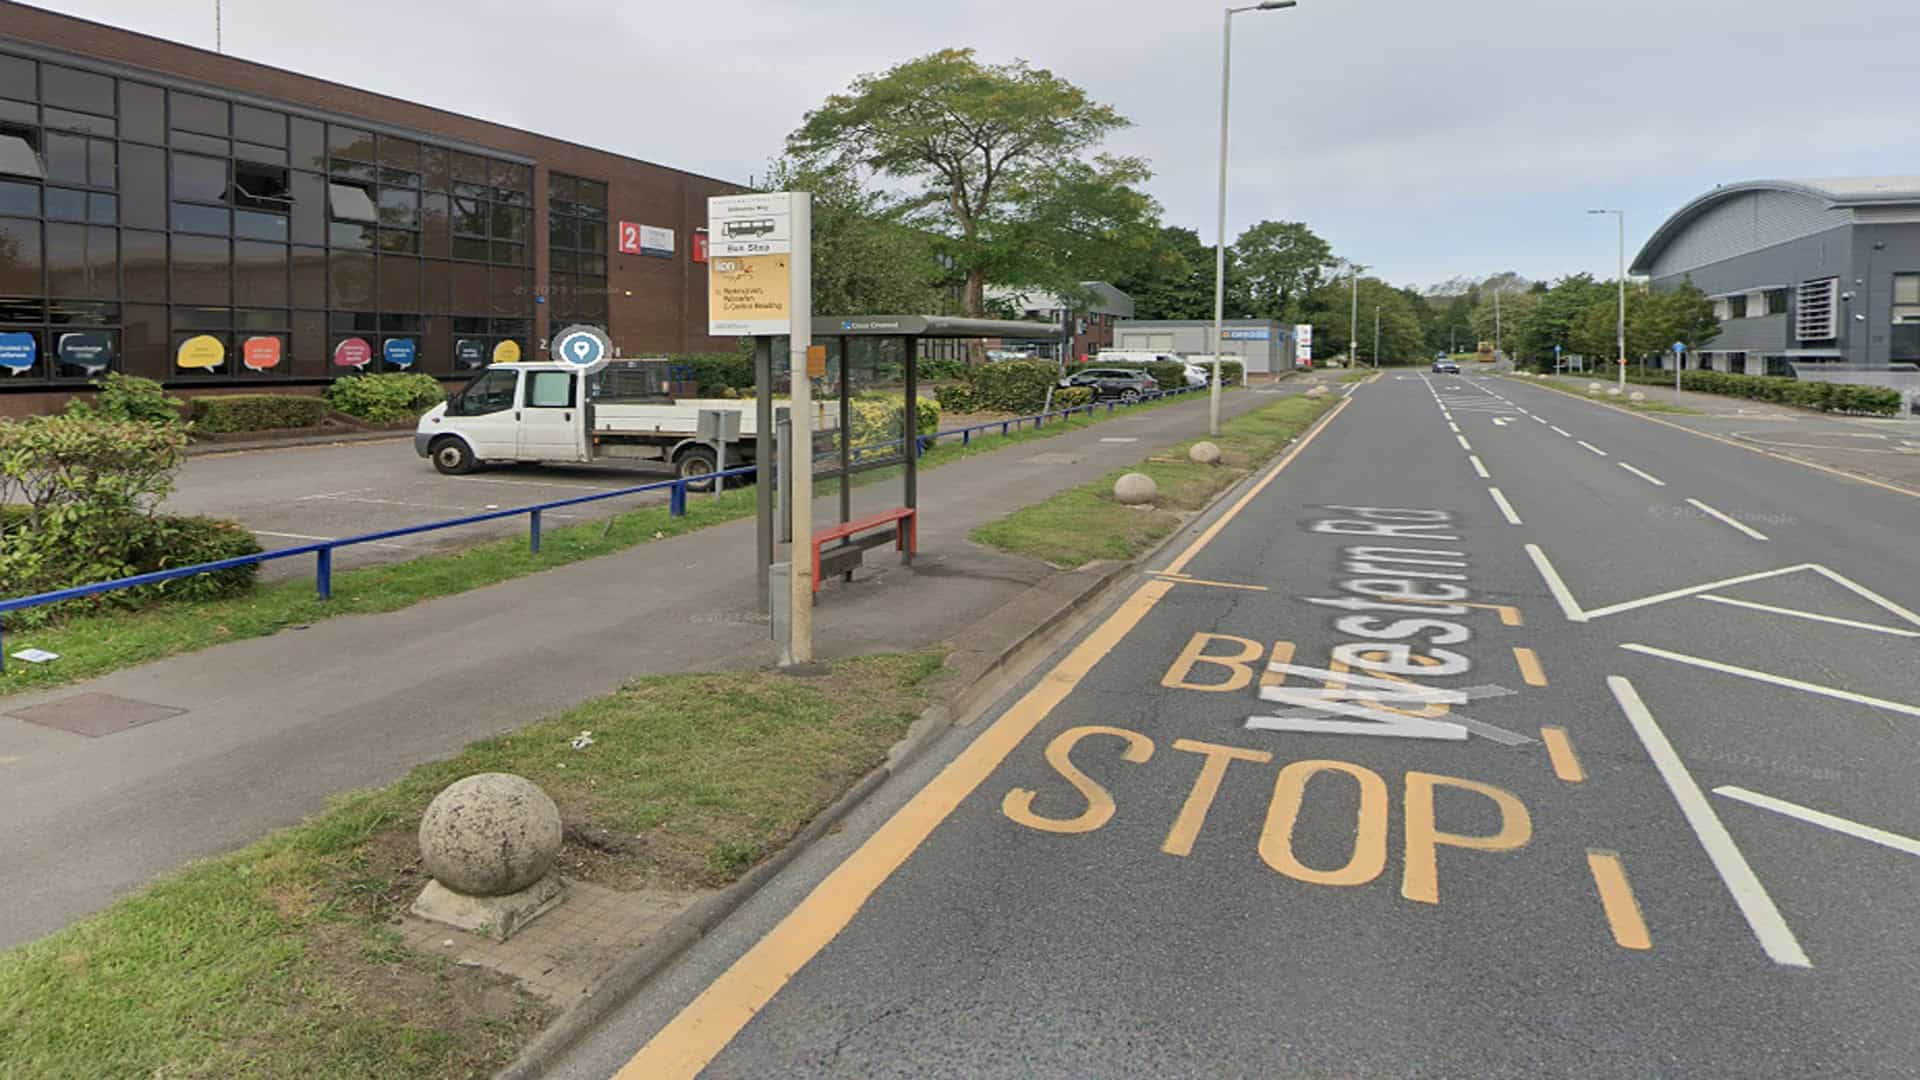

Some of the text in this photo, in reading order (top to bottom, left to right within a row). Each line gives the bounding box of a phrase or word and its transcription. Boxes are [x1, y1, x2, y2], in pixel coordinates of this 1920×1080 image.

[624, 226, 637, 249] 2
[748, 243, 770, 252] Stop
[1002, 726, 1533, 904] STOP
